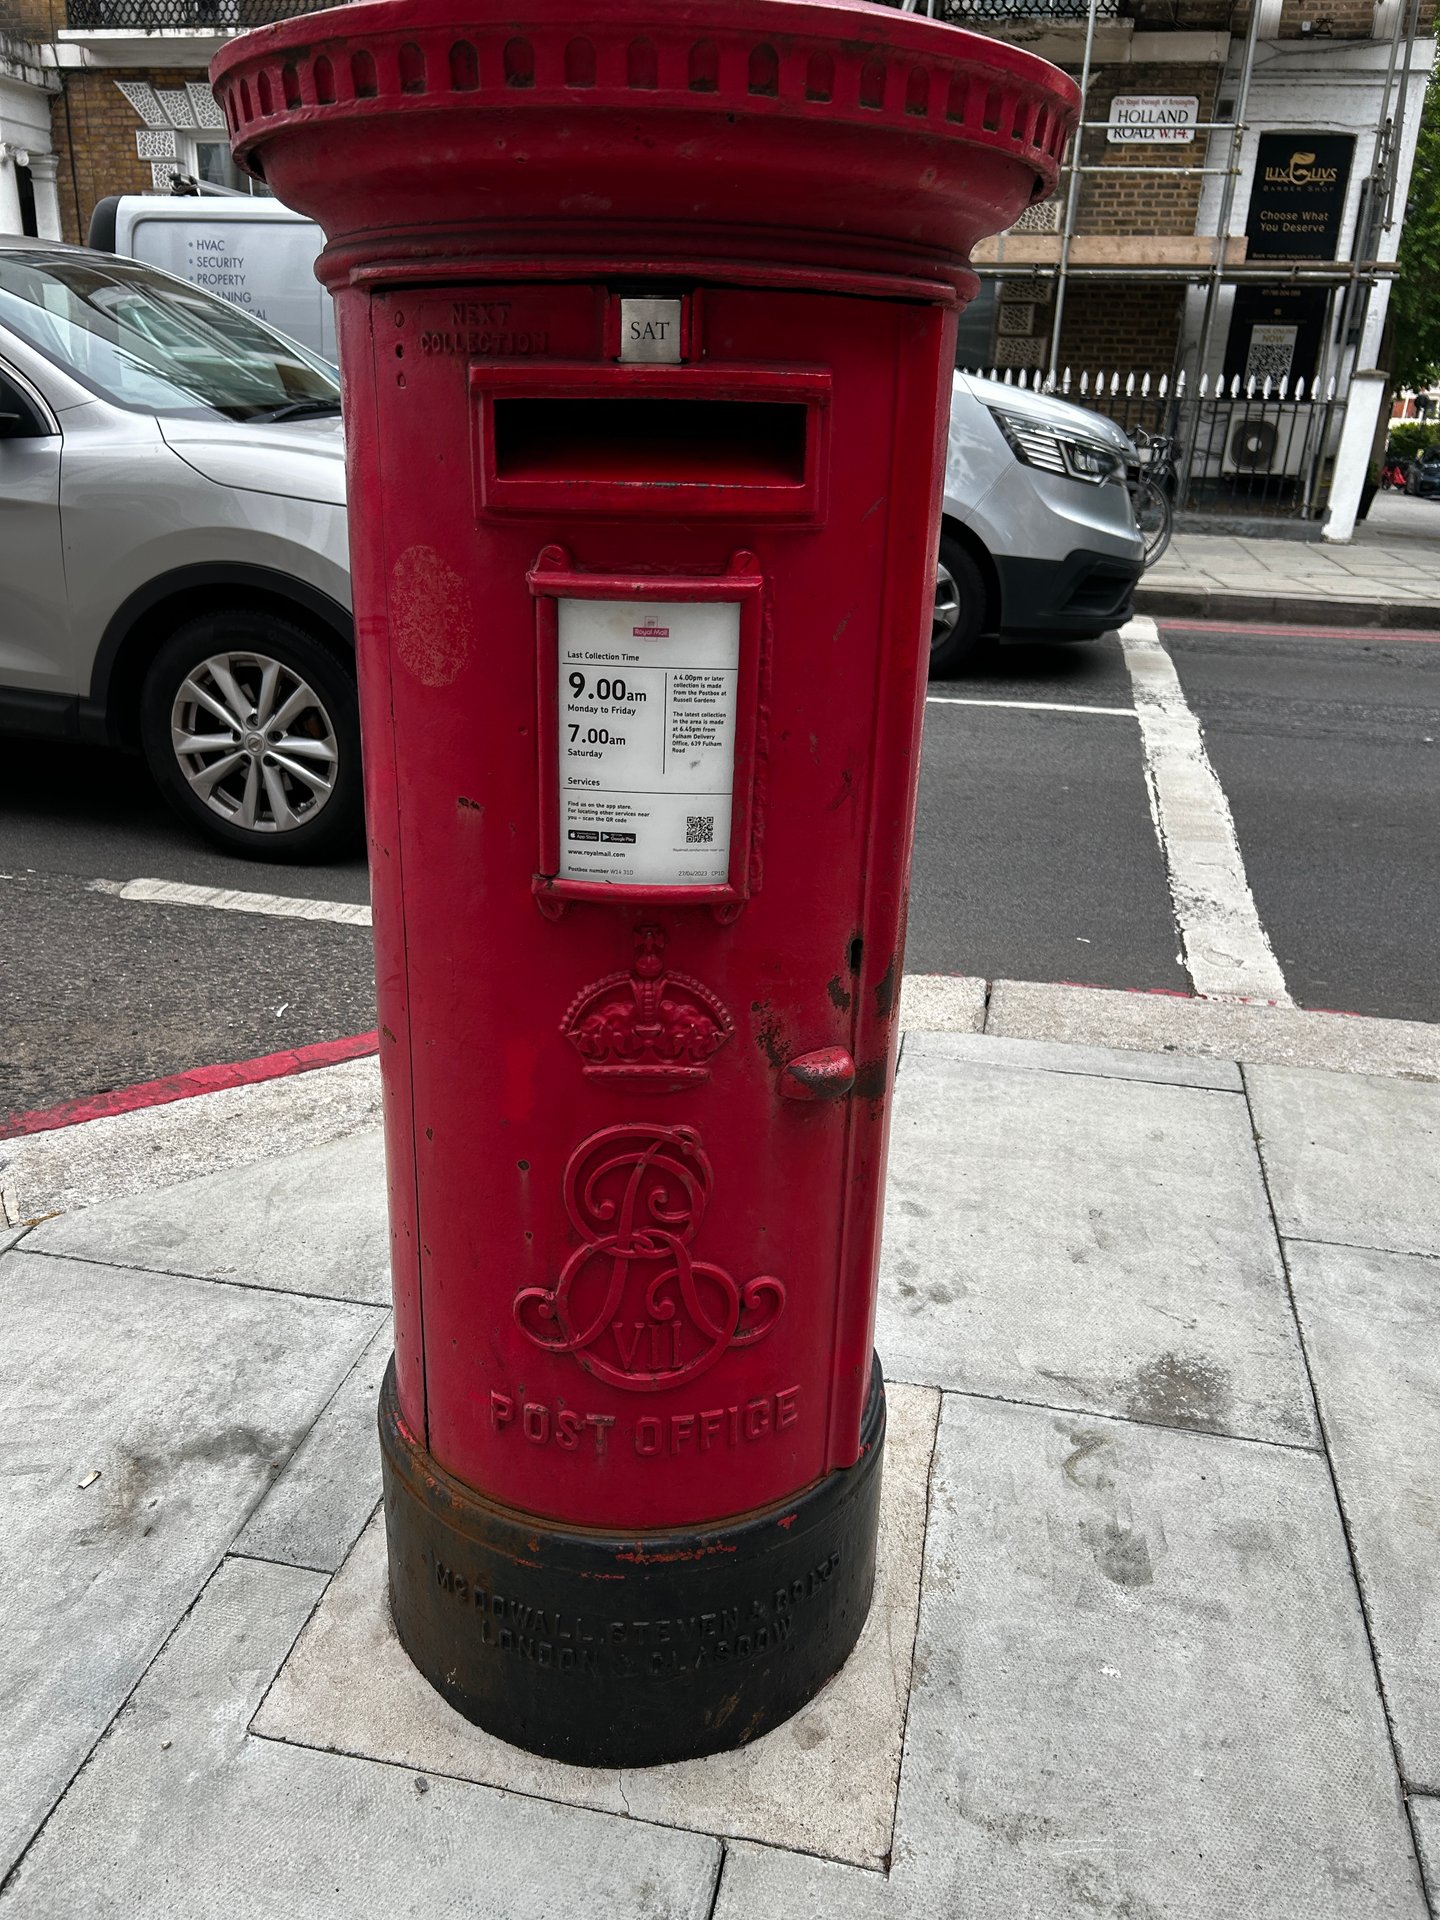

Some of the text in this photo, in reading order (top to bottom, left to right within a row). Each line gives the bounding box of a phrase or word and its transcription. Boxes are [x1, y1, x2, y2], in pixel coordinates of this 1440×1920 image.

[1117, 110, 1189, 124] HOLLAND
[1306, 184, 1335, 192] SHOP
[1260, 210, 1329, 220] Choose What
[1260, 222, 1326, 232] You Deserve
[196, 240, 225, 251] HVAC
[196, 257, 244, 268] SECURITY
[196, 274, 246, 286] PROPERTY
[451, 302, 512, 327] NEXT
[630, 320, 670, 341] SAT
[420, 331, 550, 356] COLLECTION
[634, 628, 652, 636] Royal
[585, 652, 620, 660] Collection
[679, 674, 702, 682] 4.00pm
[568, 672, 646, 702] 9.00am
[568, 704, 598, 714] Monday
[612, 706, 636, 716] Friday
[568, 724, 626, 745] 7.00am
[568, 748, 602, 759] Saturday
[568, 777, 600, 786] Services
[568, 850, 626, 858] www.royalmail.com
[612, 1319, 684, 1370] VII
[490, 1384, 801, 1457] POST OFFICE
